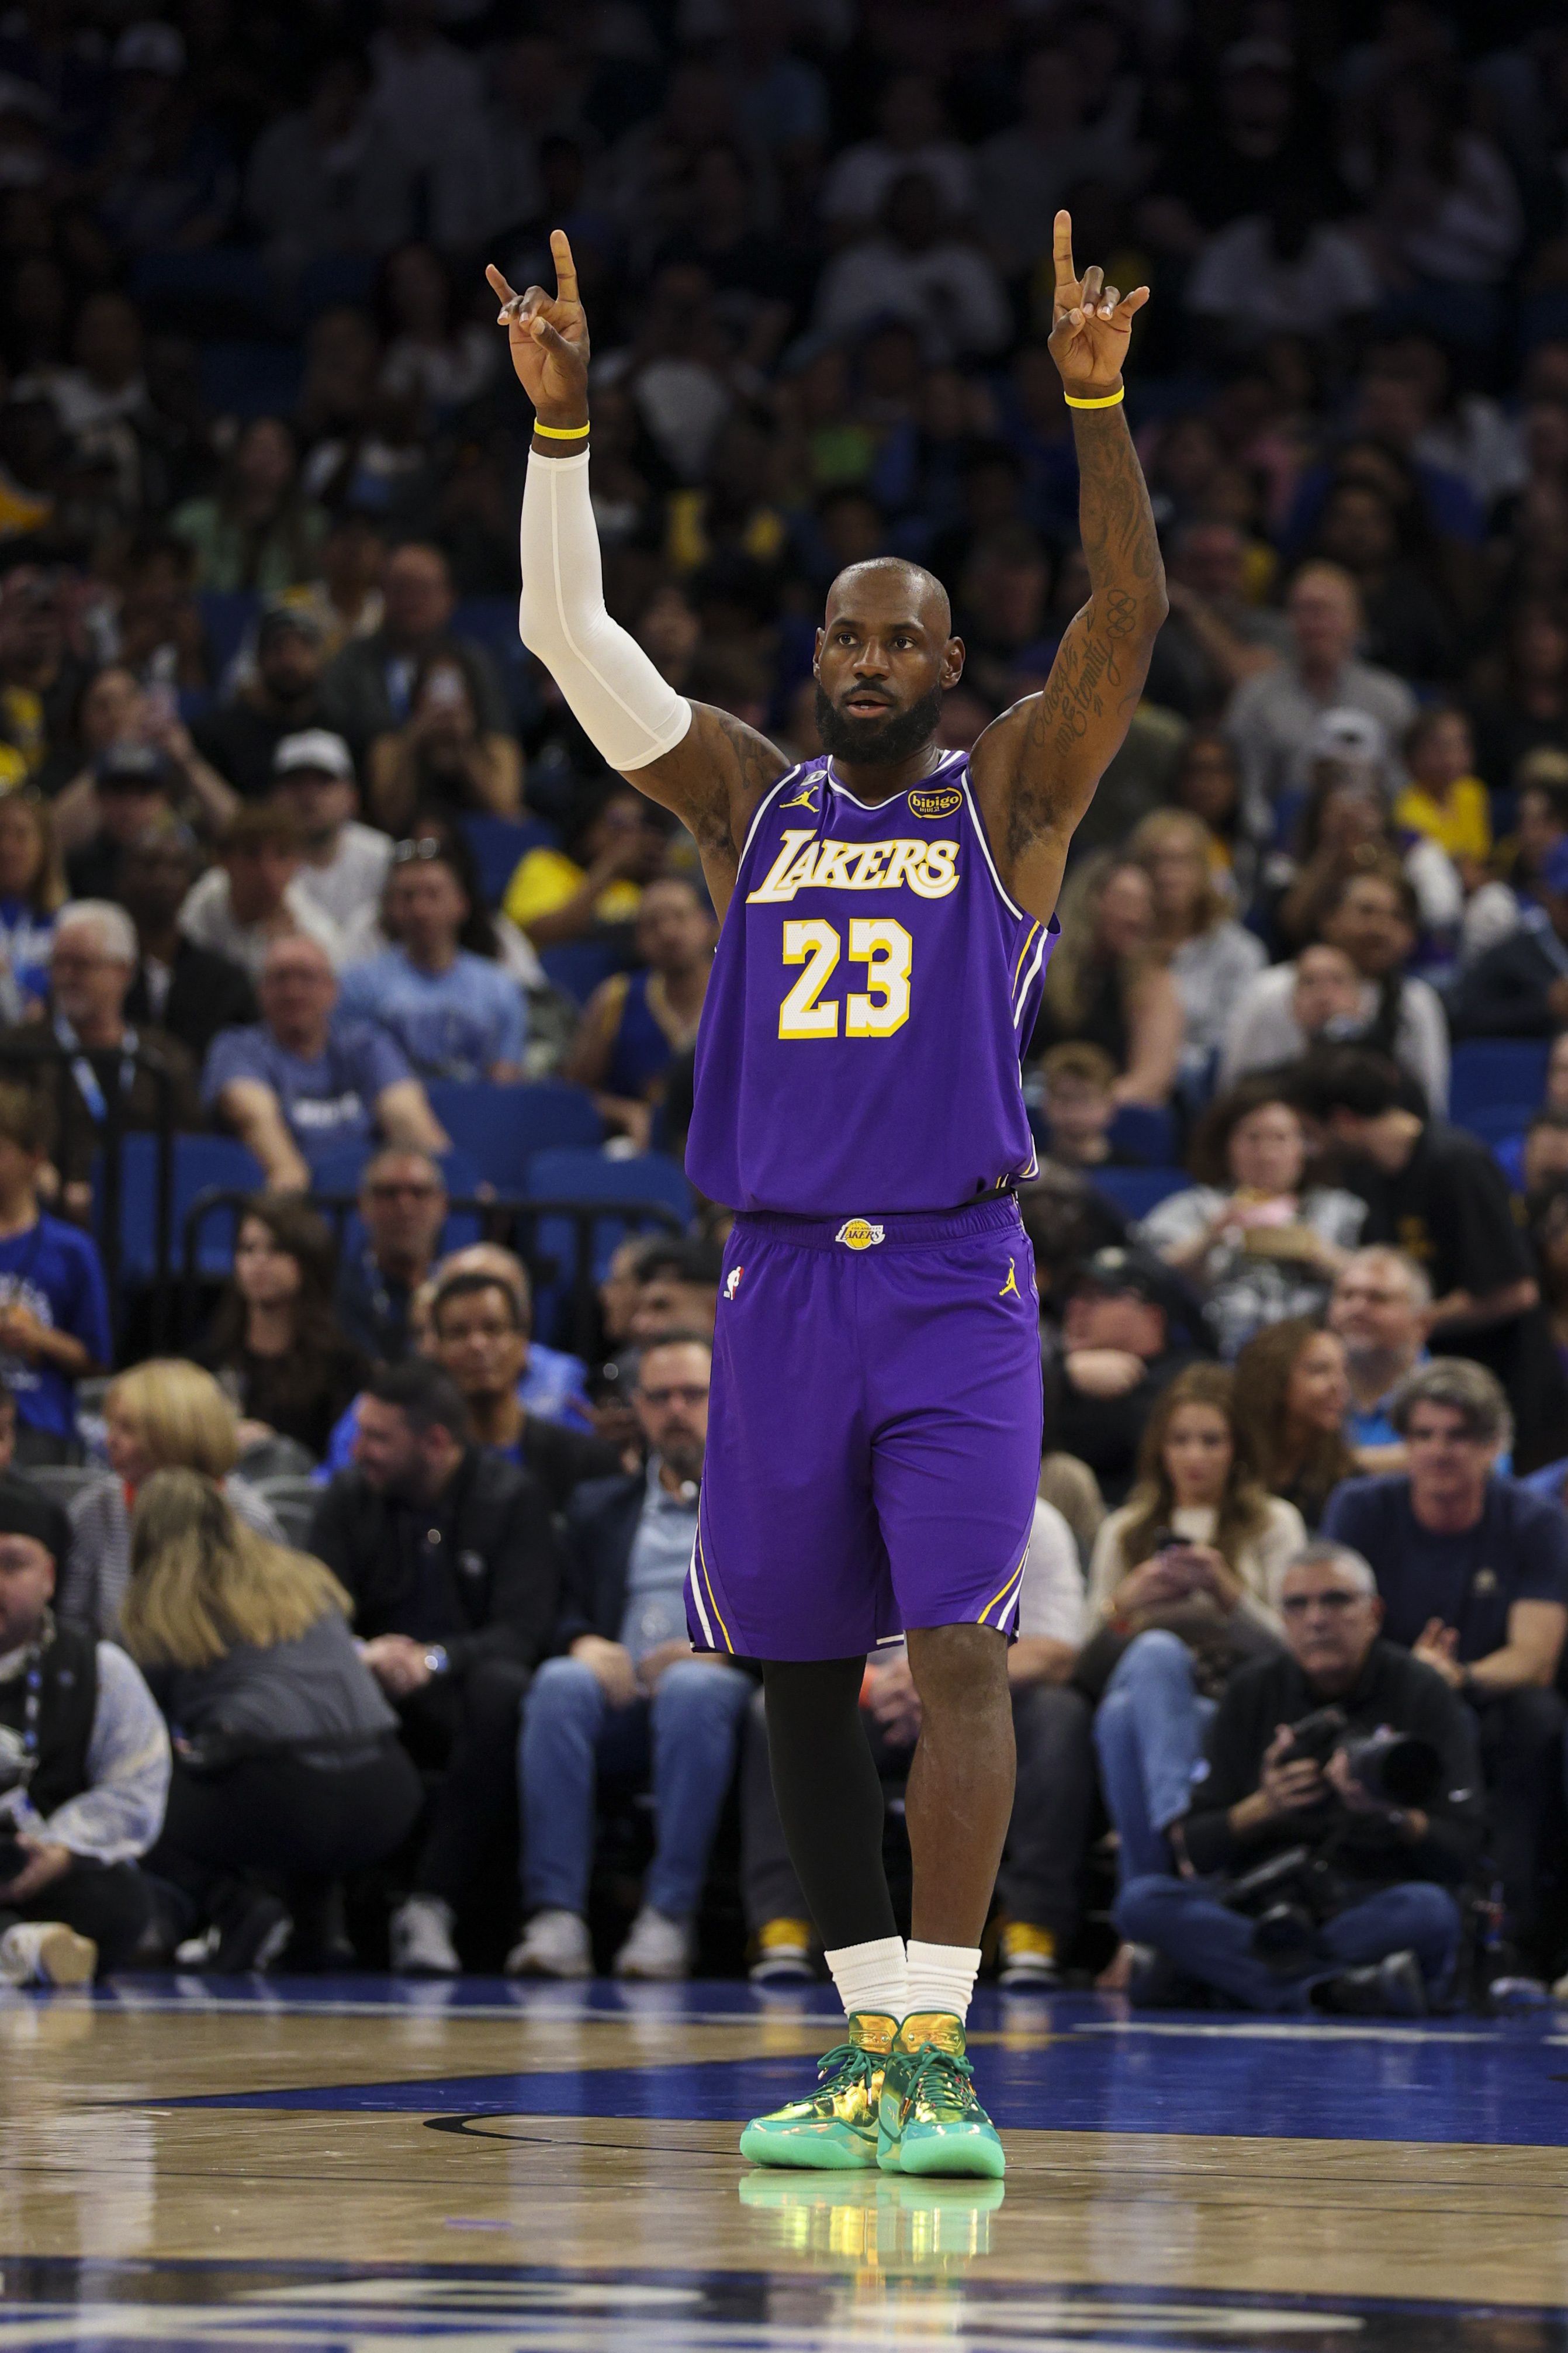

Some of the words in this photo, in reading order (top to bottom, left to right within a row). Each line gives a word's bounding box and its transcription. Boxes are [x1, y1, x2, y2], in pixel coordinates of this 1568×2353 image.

[912, 795, 959, 808] bibigo
[745, 829, 960, 903] LAKERS
[778, 919, 912, 1039] 23
[839, 1226, 883, 1243] LAKERS
